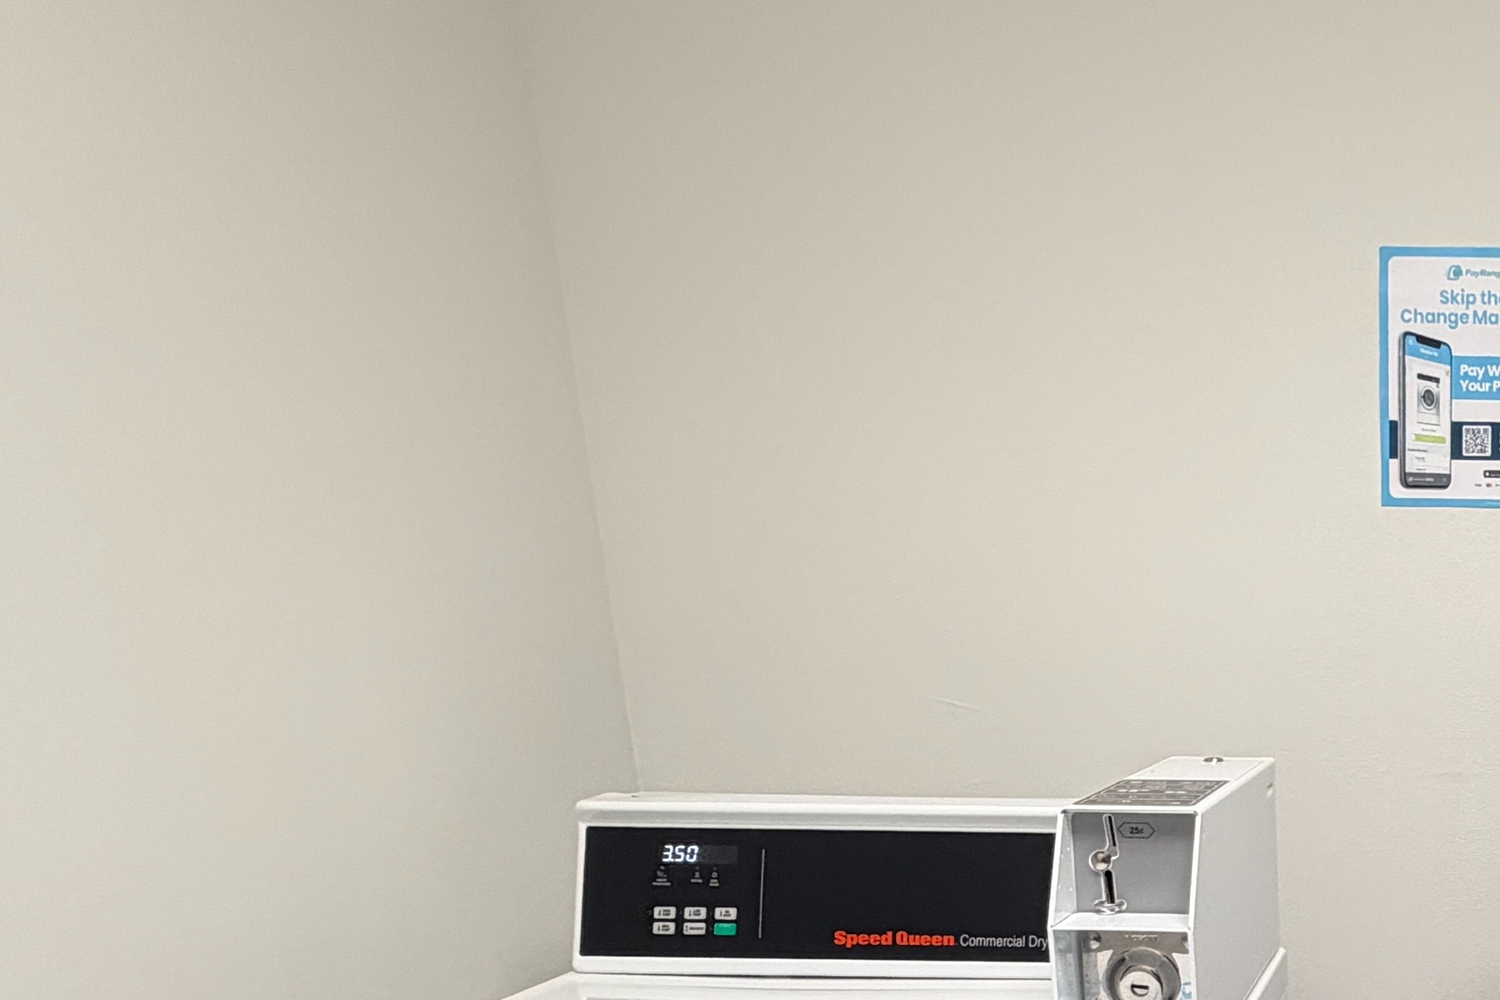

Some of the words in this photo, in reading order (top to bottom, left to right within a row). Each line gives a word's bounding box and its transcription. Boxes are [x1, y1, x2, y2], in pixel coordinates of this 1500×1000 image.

[1439, 288, 1476, 310] Skip
[1400, 308, 1470, 330] Change
[1460, 364, 1485, 380] Pay
[1459, 380, 1491, 392] Your
[662, 844, 700, 863] 3.50
[833, 930, 894, 948] Speed
[896, 930, 956, 947] Queen
[960, 934, 1026, 948] Commercial
